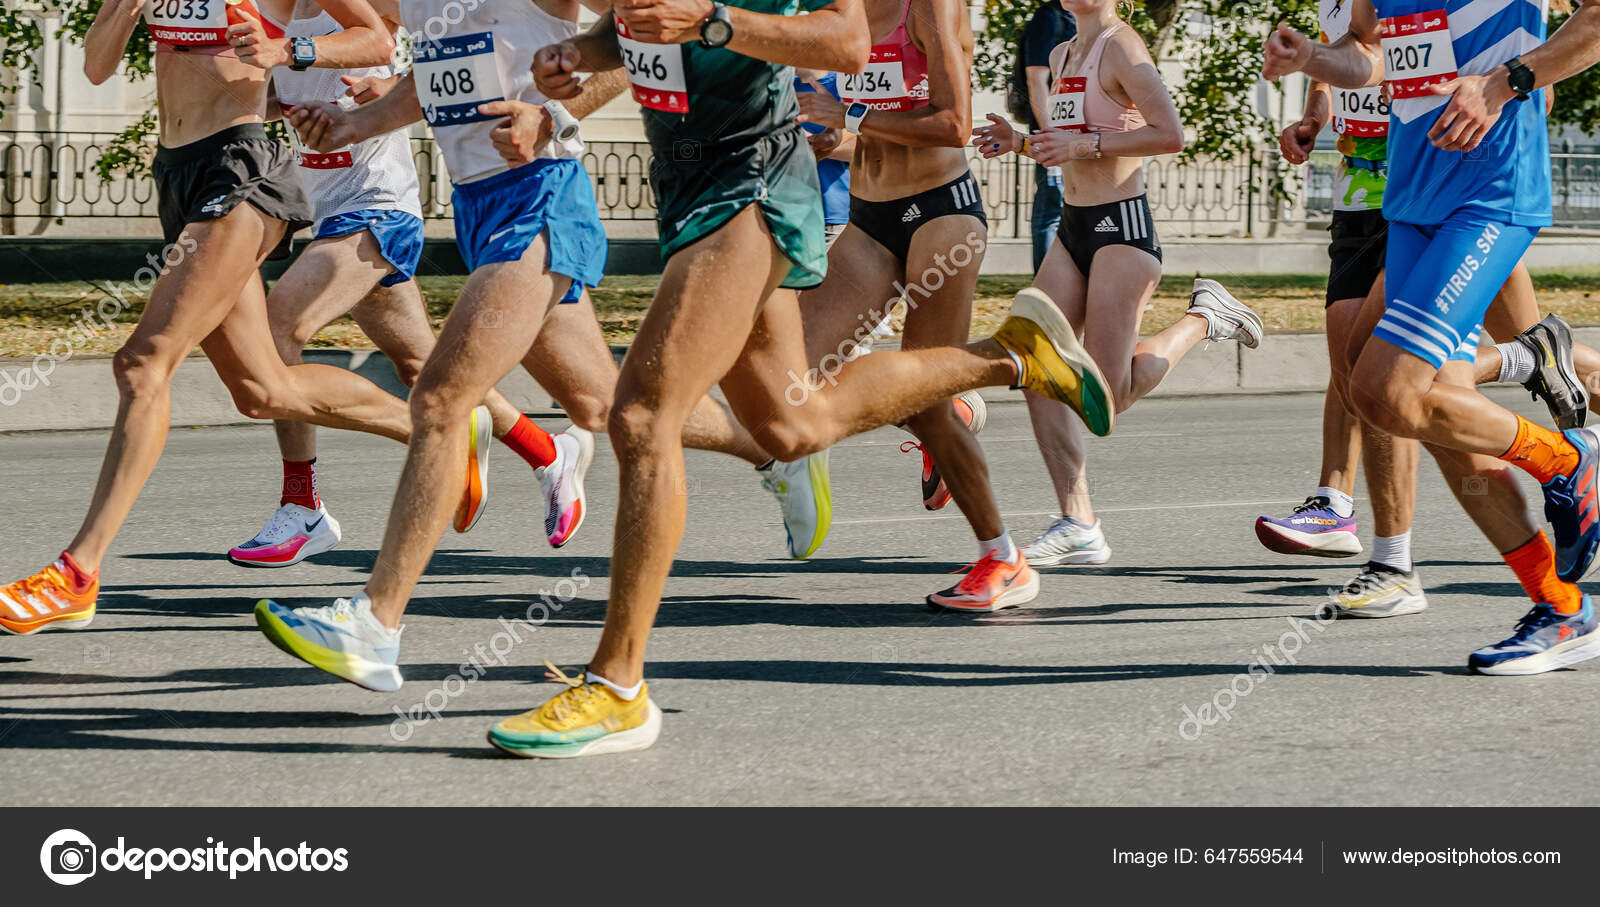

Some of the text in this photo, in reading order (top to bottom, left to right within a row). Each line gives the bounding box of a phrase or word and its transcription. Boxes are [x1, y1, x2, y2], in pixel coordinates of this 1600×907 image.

[153, 0, 209, 20] 2033
[1388, 43, 1432, 71] 1207
[430, 68, 474, 97] 408
[845, 71, 891, 92] 2034
[1340, 91, 1389, 116] 1048
[1435, 222, 1501, 314] #TIRUS_SKI
